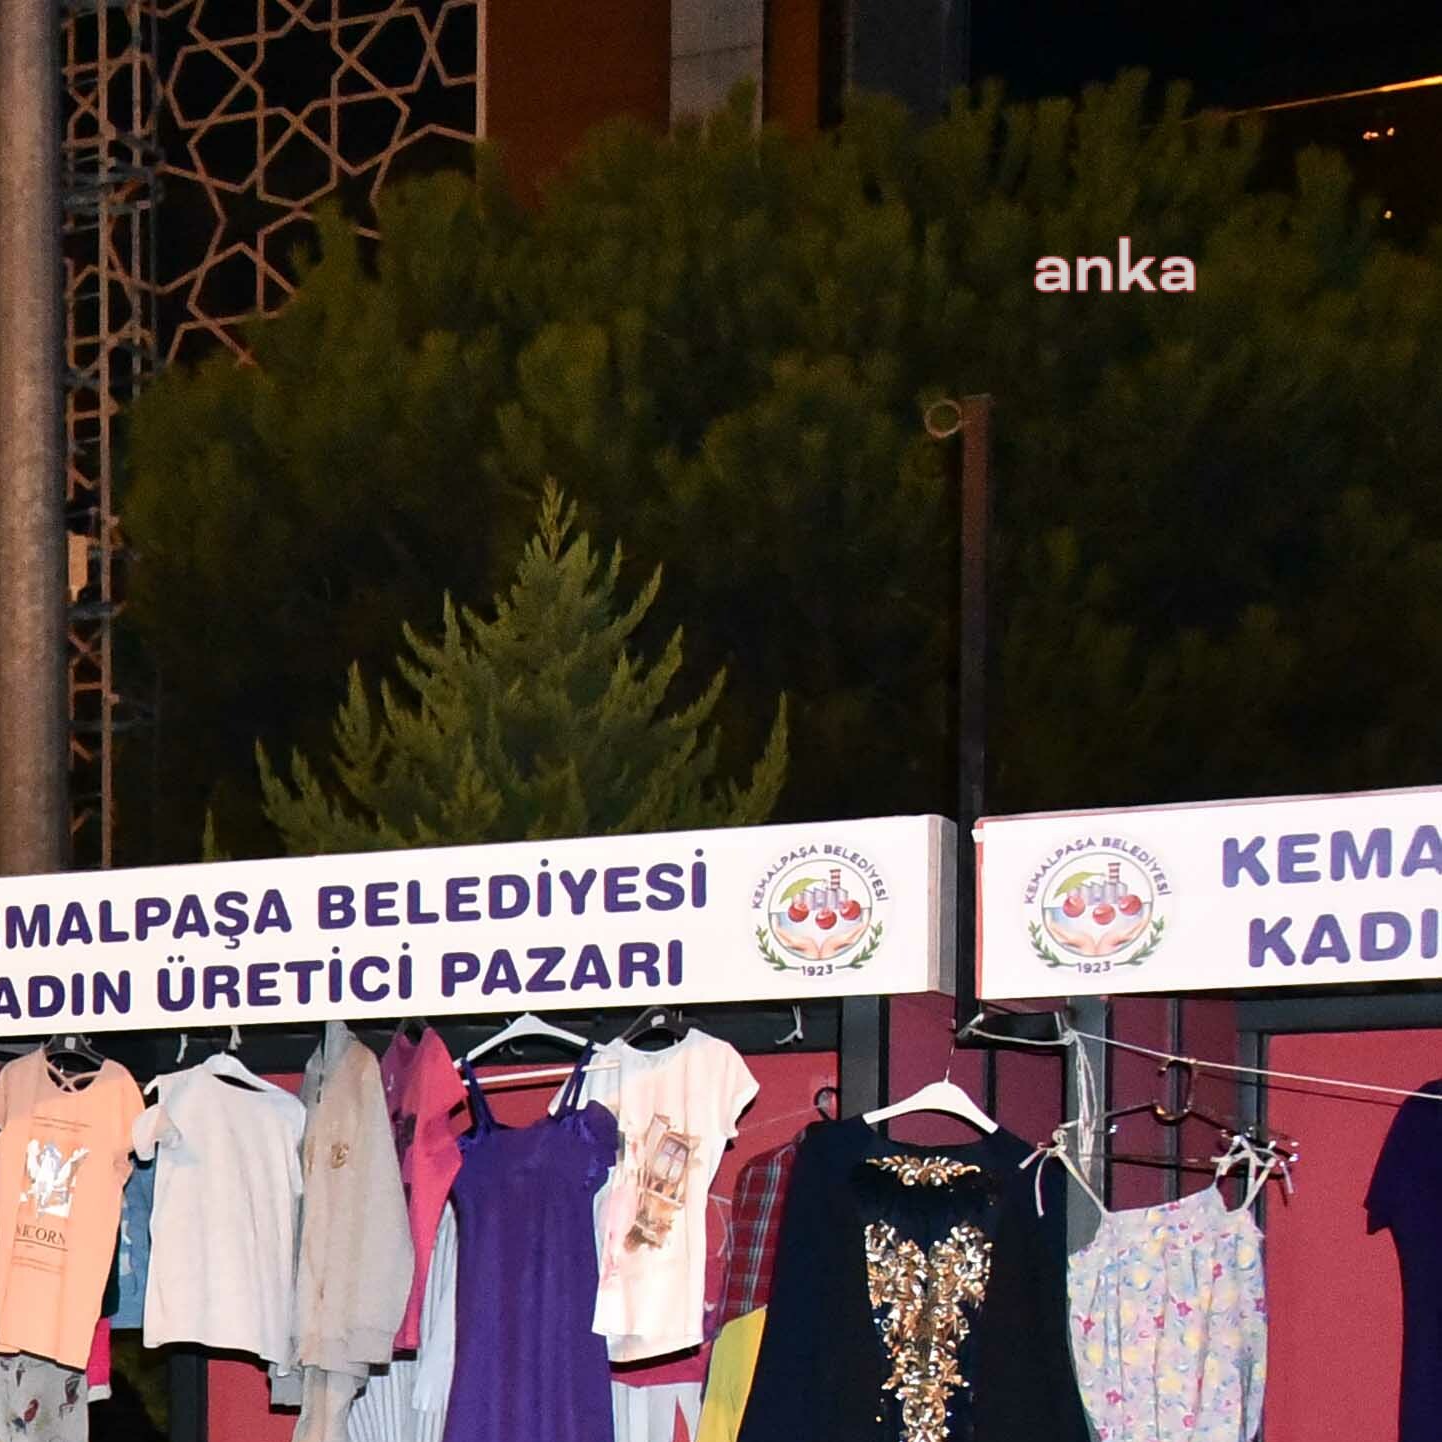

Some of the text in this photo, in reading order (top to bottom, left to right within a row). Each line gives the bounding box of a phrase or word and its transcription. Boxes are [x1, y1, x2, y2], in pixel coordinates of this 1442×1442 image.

[318, 849, 706, 929] BELEDİYESİ
[158, 943, 412, 1011] ÜRETİCİ
[442, 940, 682, 997] PAZARI
[801, 964, 833, 977] 1923
[1077, 961, 1111, 974] 1923
